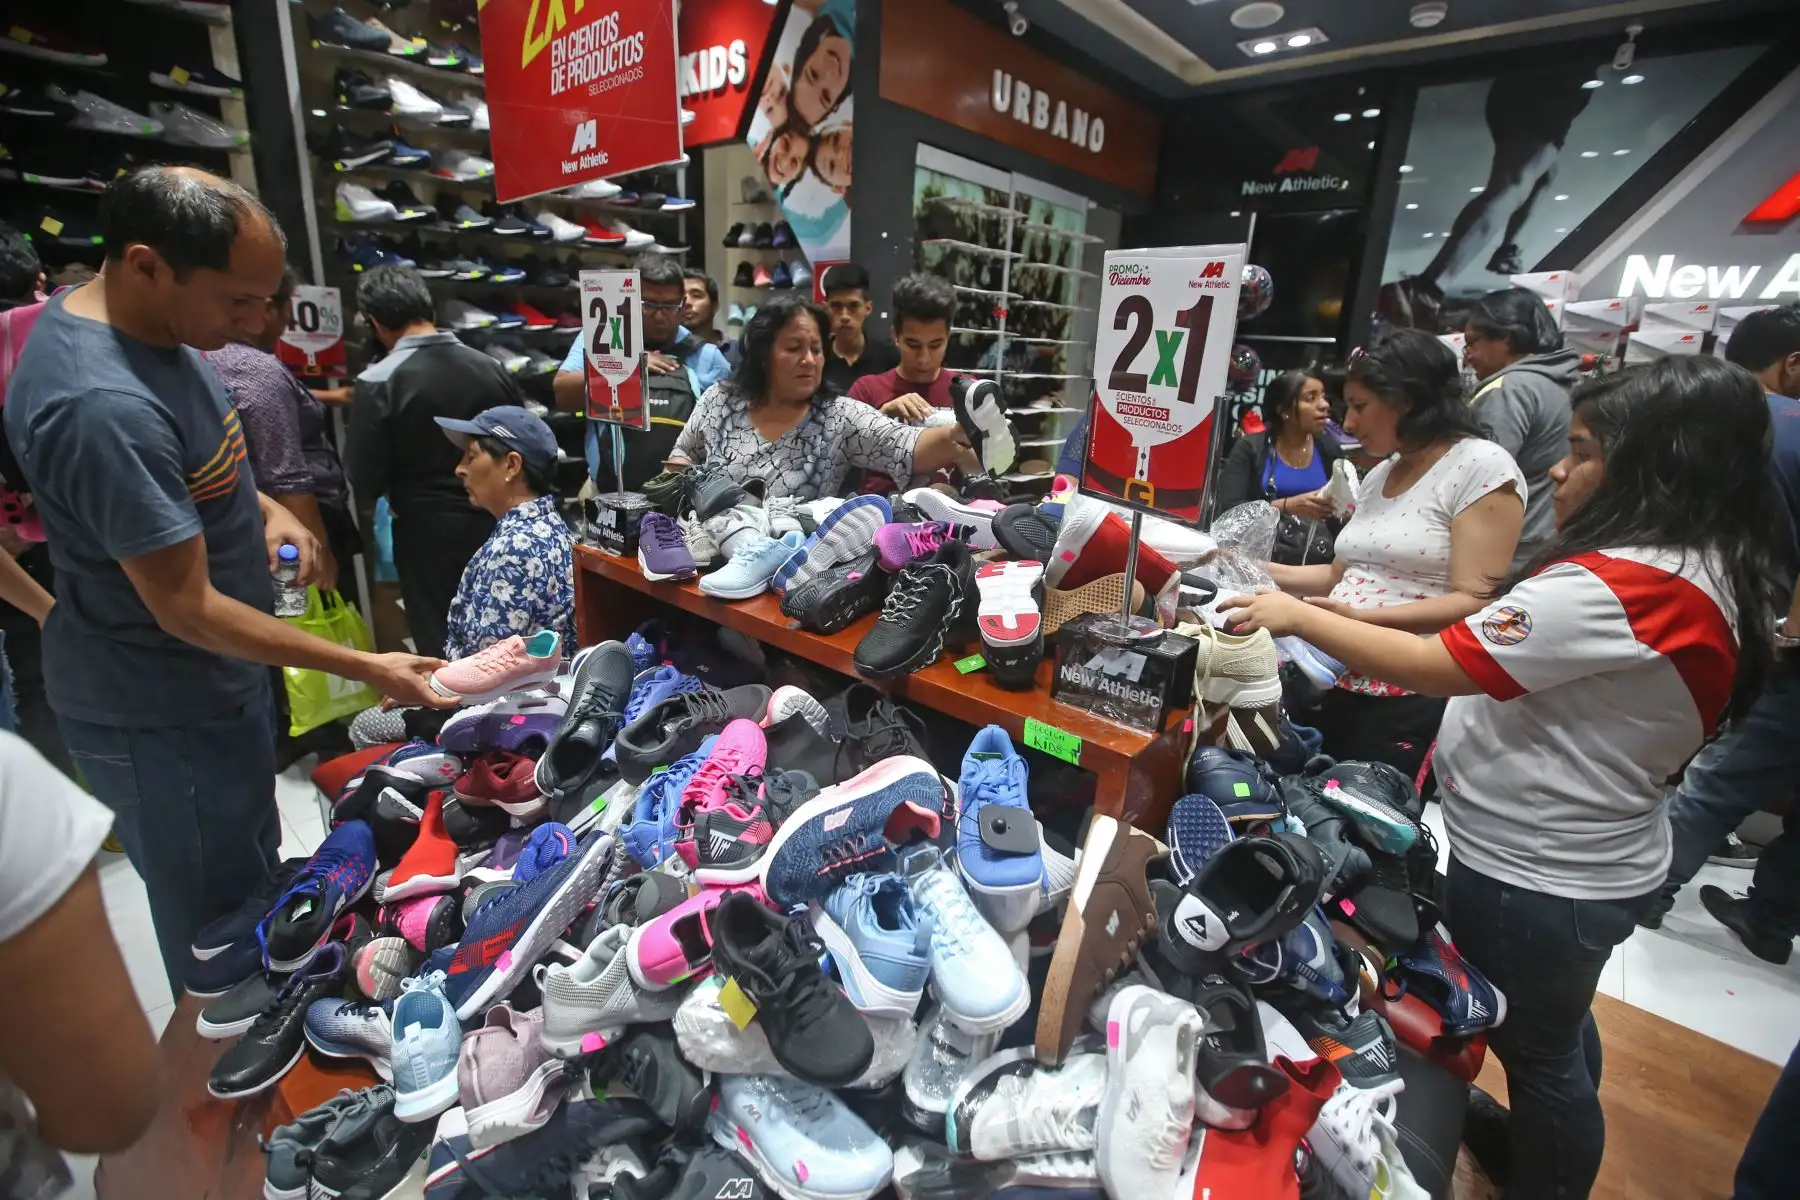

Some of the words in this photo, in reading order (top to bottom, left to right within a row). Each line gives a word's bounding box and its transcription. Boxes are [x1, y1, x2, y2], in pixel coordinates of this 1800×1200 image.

[551, 36, 566, 68] EN
[568, 11, 619, 60] CIENTOS
[551, 64, 566, 96] DE
[567, 31, 644, 89] PRODUCTOS
[679, 39, 746, 96] KIDS
[588, 66, 644, 96] SELECCIONADOS
[992, 69, 1105, 153] URBANO
[561, 160, 578, 175] New
[580, 150, 609, 170] Athletic
[1242, 181, 1277, 196] New
[1279, 175, 1340, 193] Athletic
[1108, 264, 1140, 275] PROMO
[1108, 271, 1152, 286] Diciembre
[1617, 254, 1761, 299] New
[1188, 280, 1203, 289] New
[1205, 280, 1231, 289] Athletic
[1118, 403, 1168, 419] PRODUCTOS
[1121, 393, 1152, 406] CIENTOS
[1123, 416, 1182, 433] SELECCIONADOS
[588, 522, 602, 535] New
[602, 527, 625, 543] Athletic
[1060, 665, 1096, 688] New
[1097, 678, 1162, 708] Athletic
